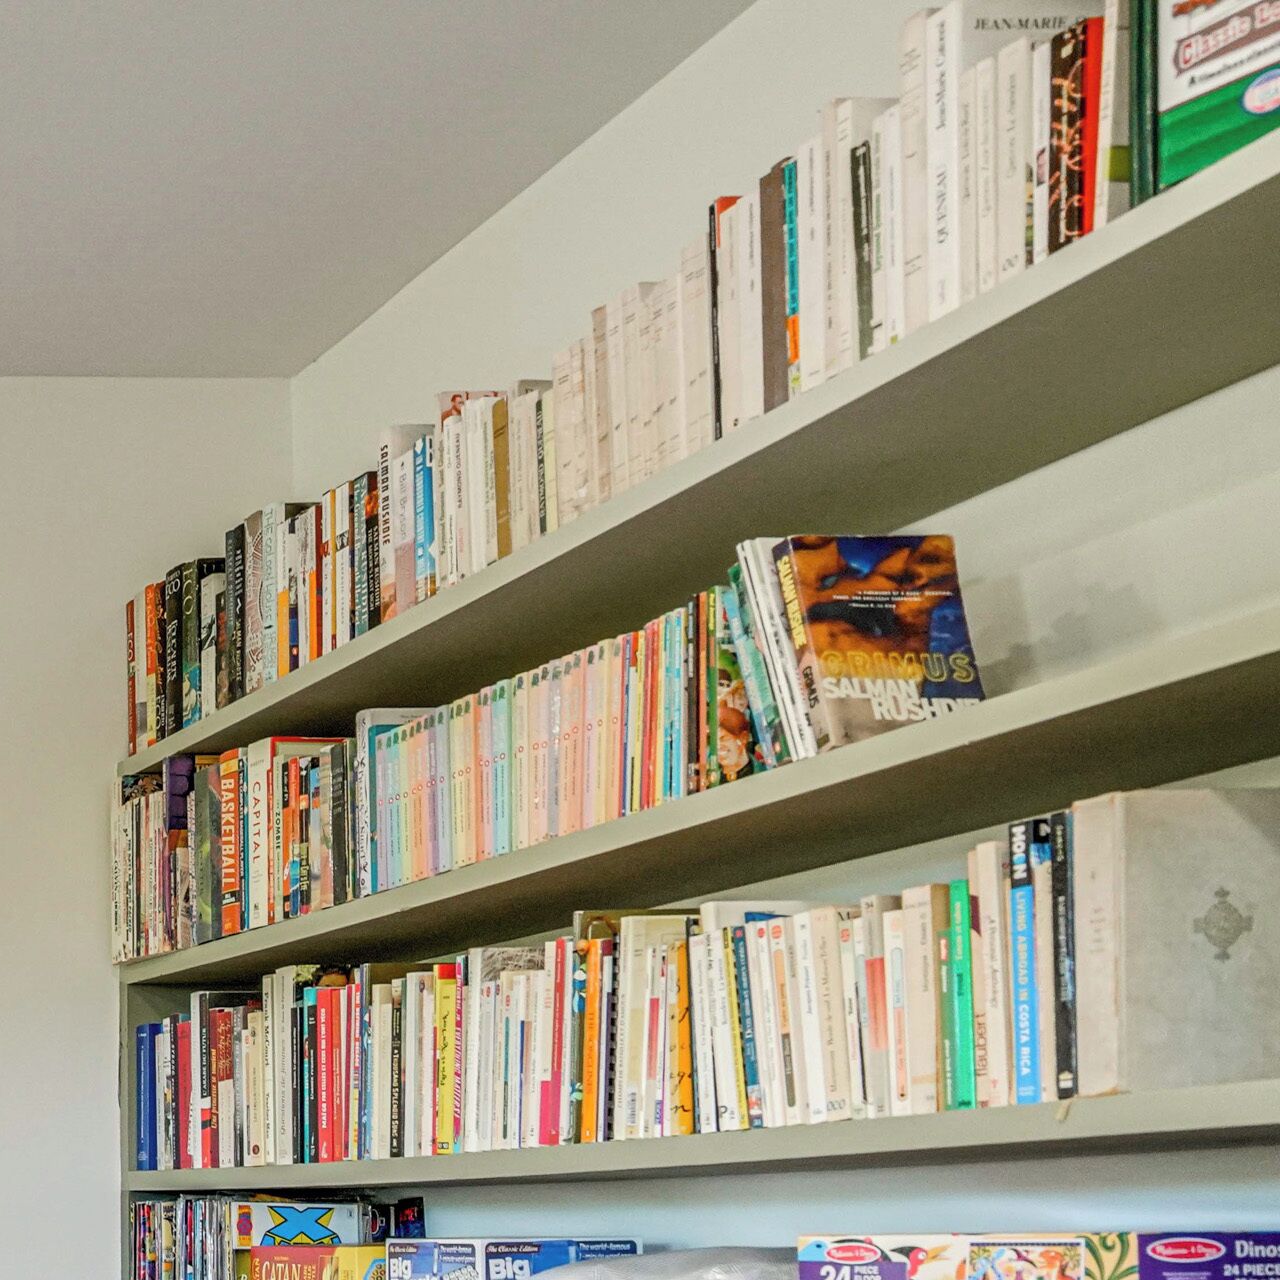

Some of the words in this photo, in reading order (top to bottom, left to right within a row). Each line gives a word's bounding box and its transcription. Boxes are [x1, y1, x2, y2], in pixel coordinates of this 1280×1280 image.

[381, 444, 389, 492] SALMAN
[399, 474, 407, 492] Bill
[382, 496, 391, 545] RUSHDIE
[399, 497, 408, 542] Bryson
[372, 525, 380, 563] SALMAN
[127, 632, 136, 662] ECO
[820, 650, 976, 683] GRIMUS
[822, 677, 918, 700] SALMAN
[221, 778, 236, 890] BASKETBALL
[252, 781, 261, 864] CAPITAL
[1011, 825, 1028, 879] MOON
[1015, 890, 1027, 931] LIVING
[989, 925, 999, 964] Personal
[1016, 935, 1028, 985] ABROAD
[264, 992, 272, 1022] Frank
[990, 969, 1001, 1009] Anthology
[1018, 1004, 1029, 1043] COSTA
[264, 1027, 272, 1066] McCourt
[974, 1012, 988, 1077] flaubert
[1020, 1047, 1031, 1076] RICA
[280, 1092, 288, 1136] Questions
[498, 1245, 518, 1253] Classic
[589, 1243, 631, 1251] world-famous
[389, 1257, 412, 1280] Big
[489, 1257, 532, 1280] Big
[854, 1266, 879, 1275] PIECE
[1223, 1264, 1240, 1277] 24
